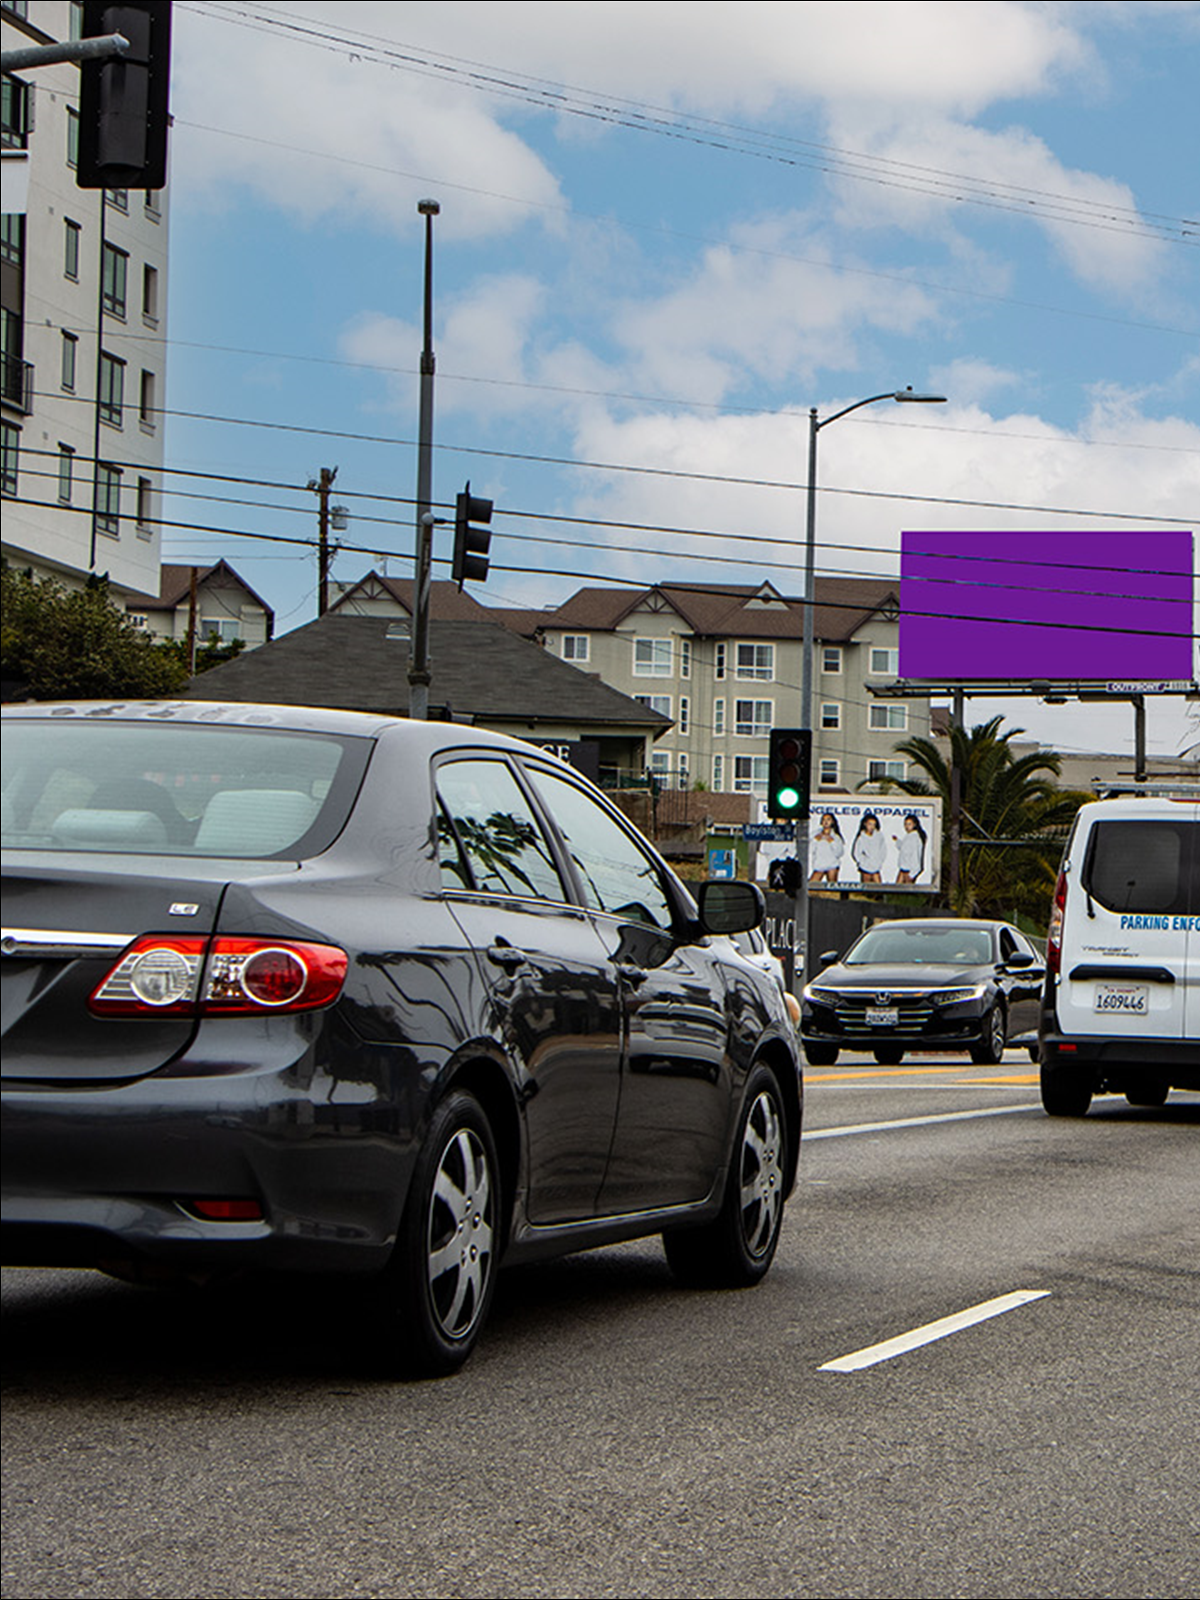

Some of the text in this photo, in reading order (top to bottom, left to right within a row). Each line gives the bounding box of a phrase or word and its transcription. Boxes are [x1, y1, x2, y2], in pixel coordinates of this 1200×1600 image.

[809, 805, 930, 818] NGELES APPAREL
[1120, 915, 1169, 931] PARKING
[765, 916, 797, 950] PLAC
[1096, 994, 1145, 1010] 1609446
